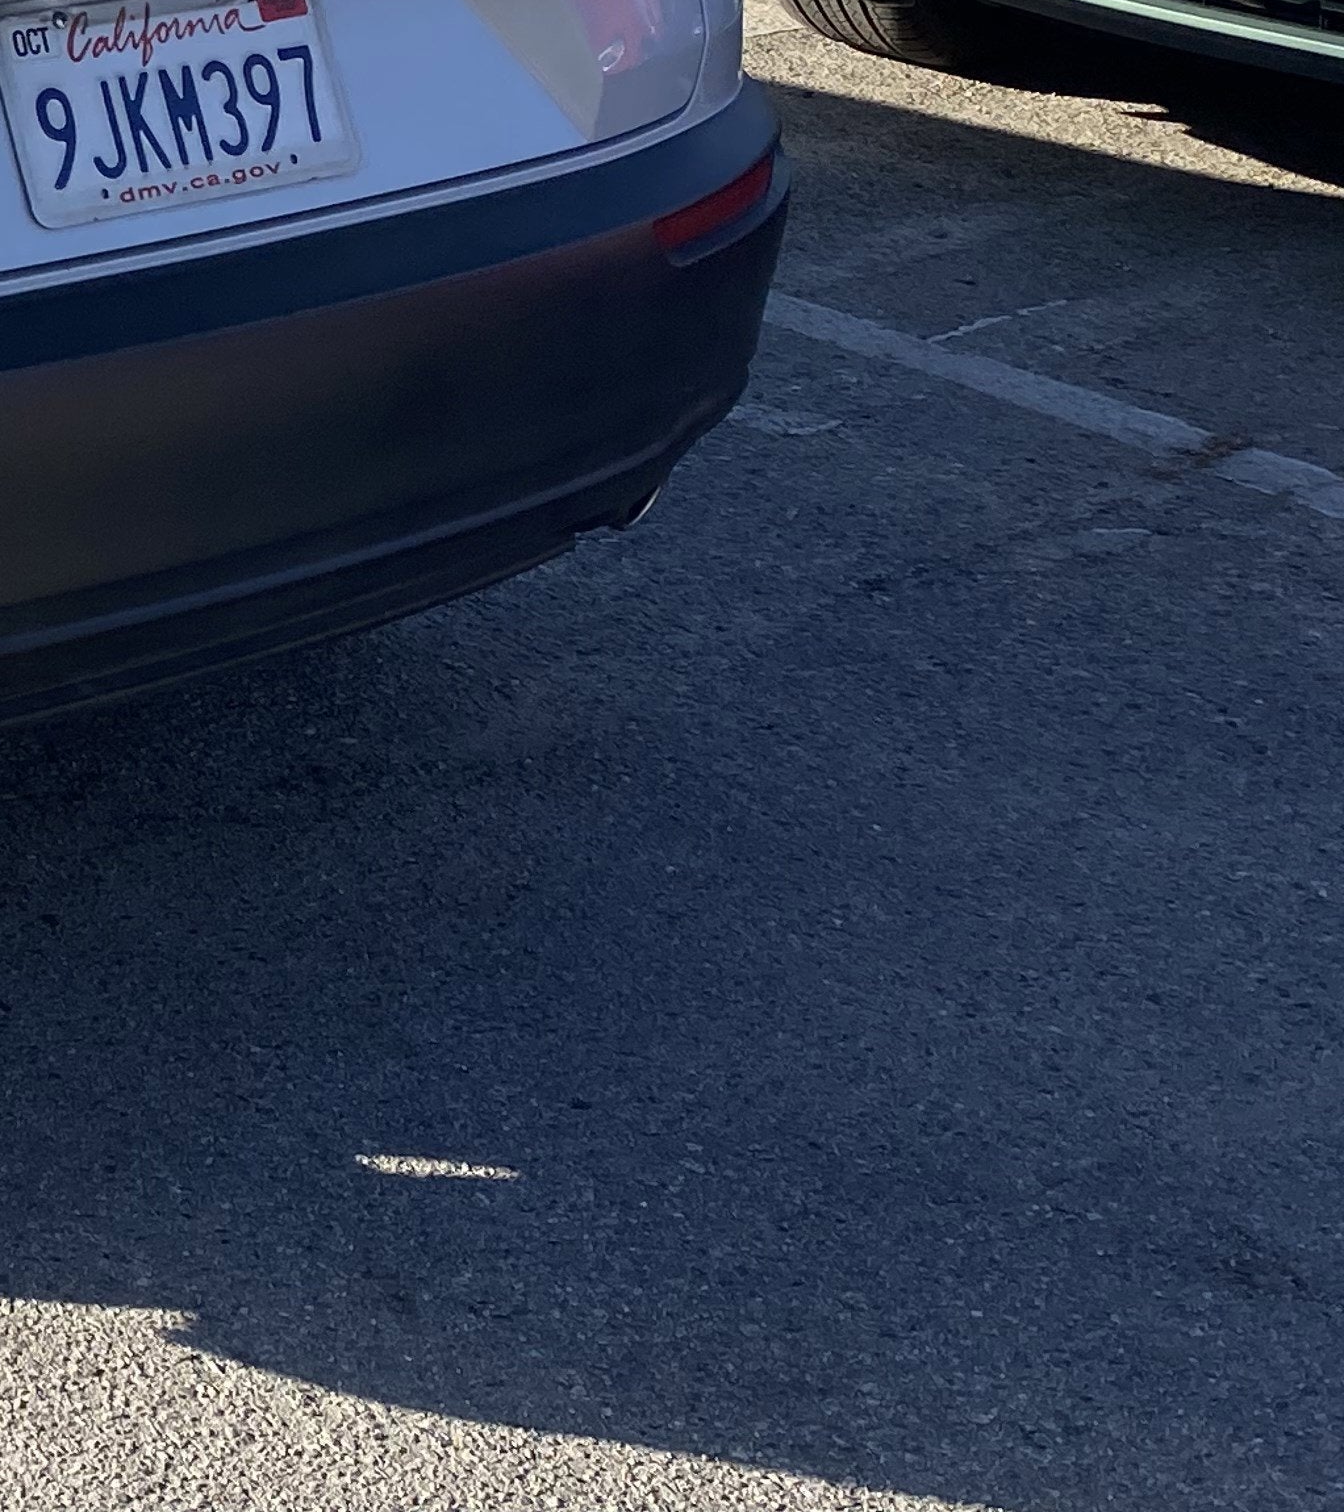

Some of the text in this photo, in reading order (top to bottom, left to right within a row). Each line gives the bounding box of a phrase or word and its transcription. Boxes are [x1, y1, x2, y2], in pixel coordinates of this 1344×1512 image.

[12, 1, 265, 66] OCT California
[35, 45, 322, 190] 9JKM397
[119, 161, 281, 203] dmv.ca.gov
